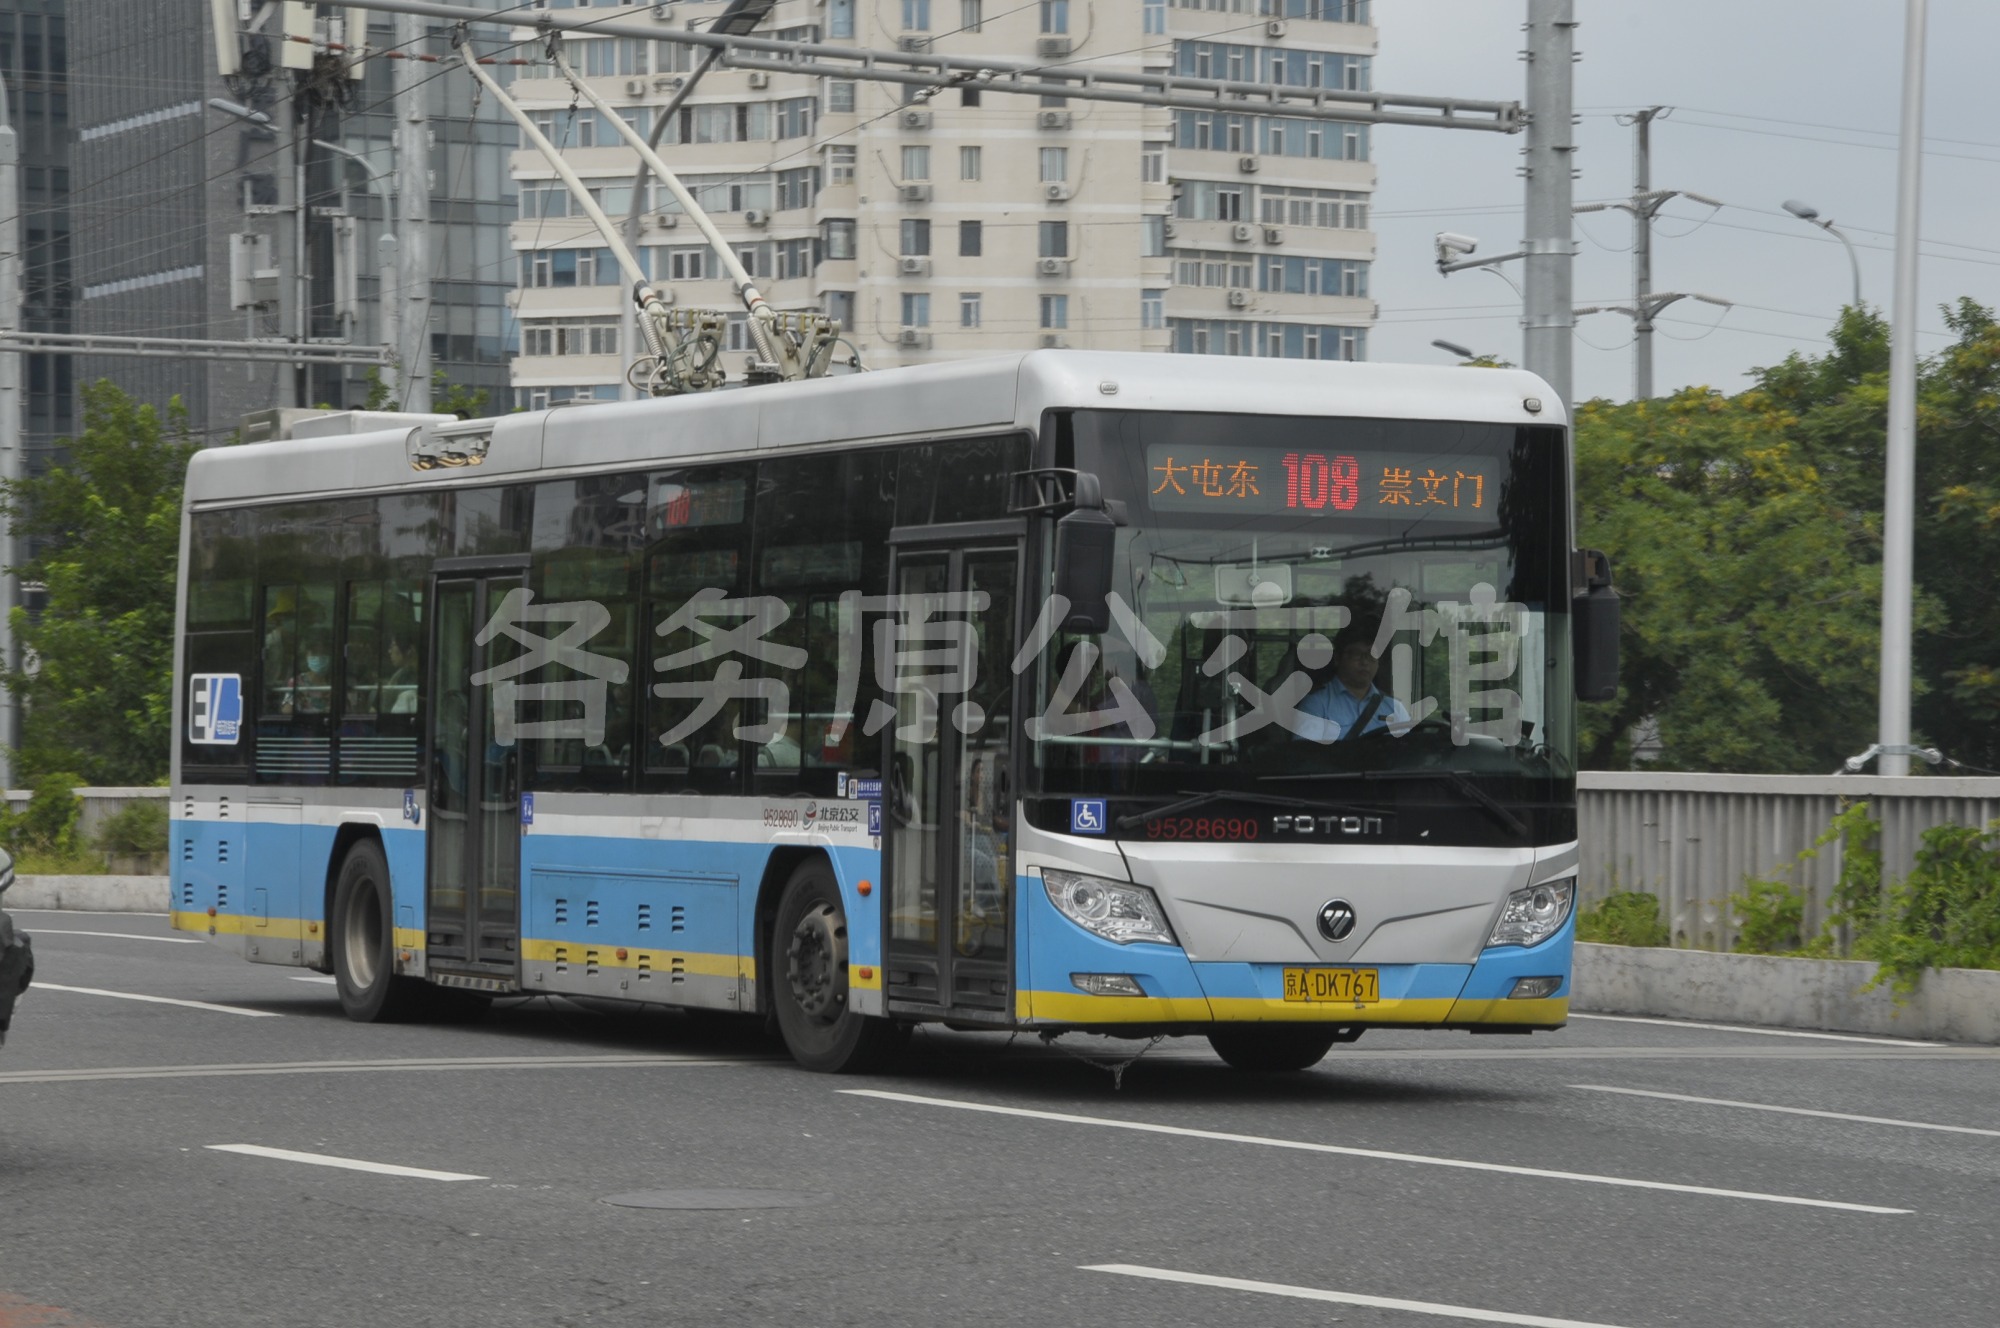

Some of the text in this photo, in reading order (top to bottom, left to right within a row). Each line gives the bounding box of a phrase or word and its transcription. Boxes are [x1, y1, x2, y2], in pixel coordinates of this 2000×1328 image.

[1153, 453, 1484, 510] 大屯东 108 崇文门
[763, 808, 798, 828] 9528690
[819, 806, 859, 822] 北京公交
[1146, 818, 1258, 840] 9528690
[1272, 815, 1382, 835] FOTON
